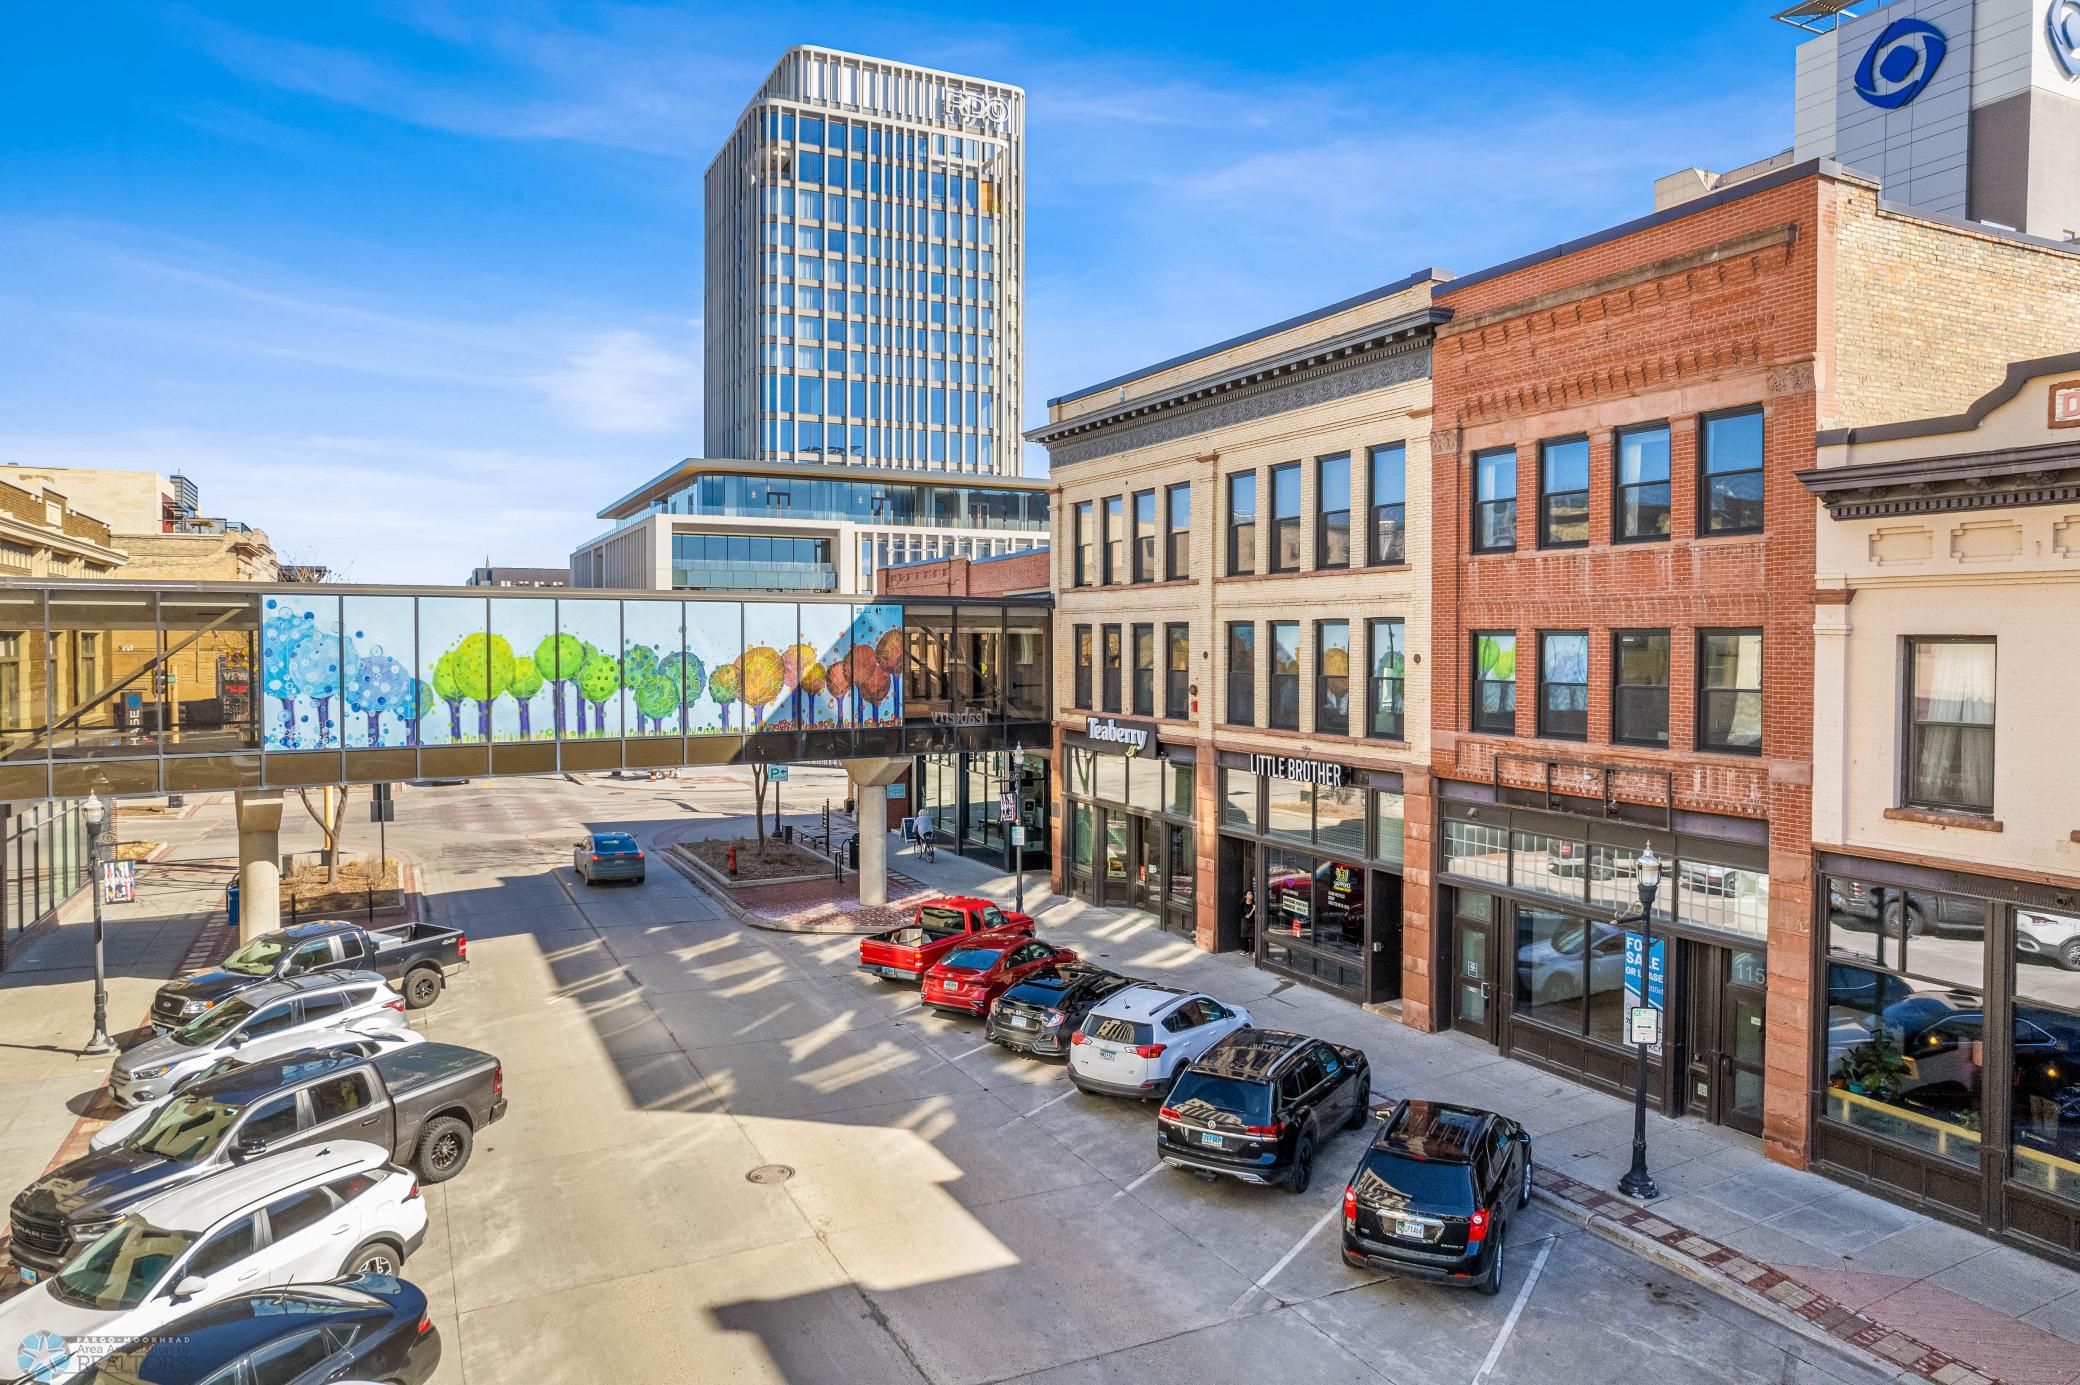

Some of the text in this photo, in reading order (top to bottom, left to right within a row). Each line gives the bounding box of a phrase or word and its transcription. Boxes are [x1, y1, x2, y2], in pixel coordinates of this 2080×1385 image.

[945, 88, 1009, 123] RDO
[129, 709, 140, 746] HASE
[1087, 717, 1148, 751] Teaberry
[1250, 753, 1341, 787] LITTLE BROTHER
[1626, 936, 1643, 953] FO
[1626, 951, 1660, 971] SAE
[1736, 963, 1765, 984] 115
[1625, 966, 1664, 984] OR LASE
